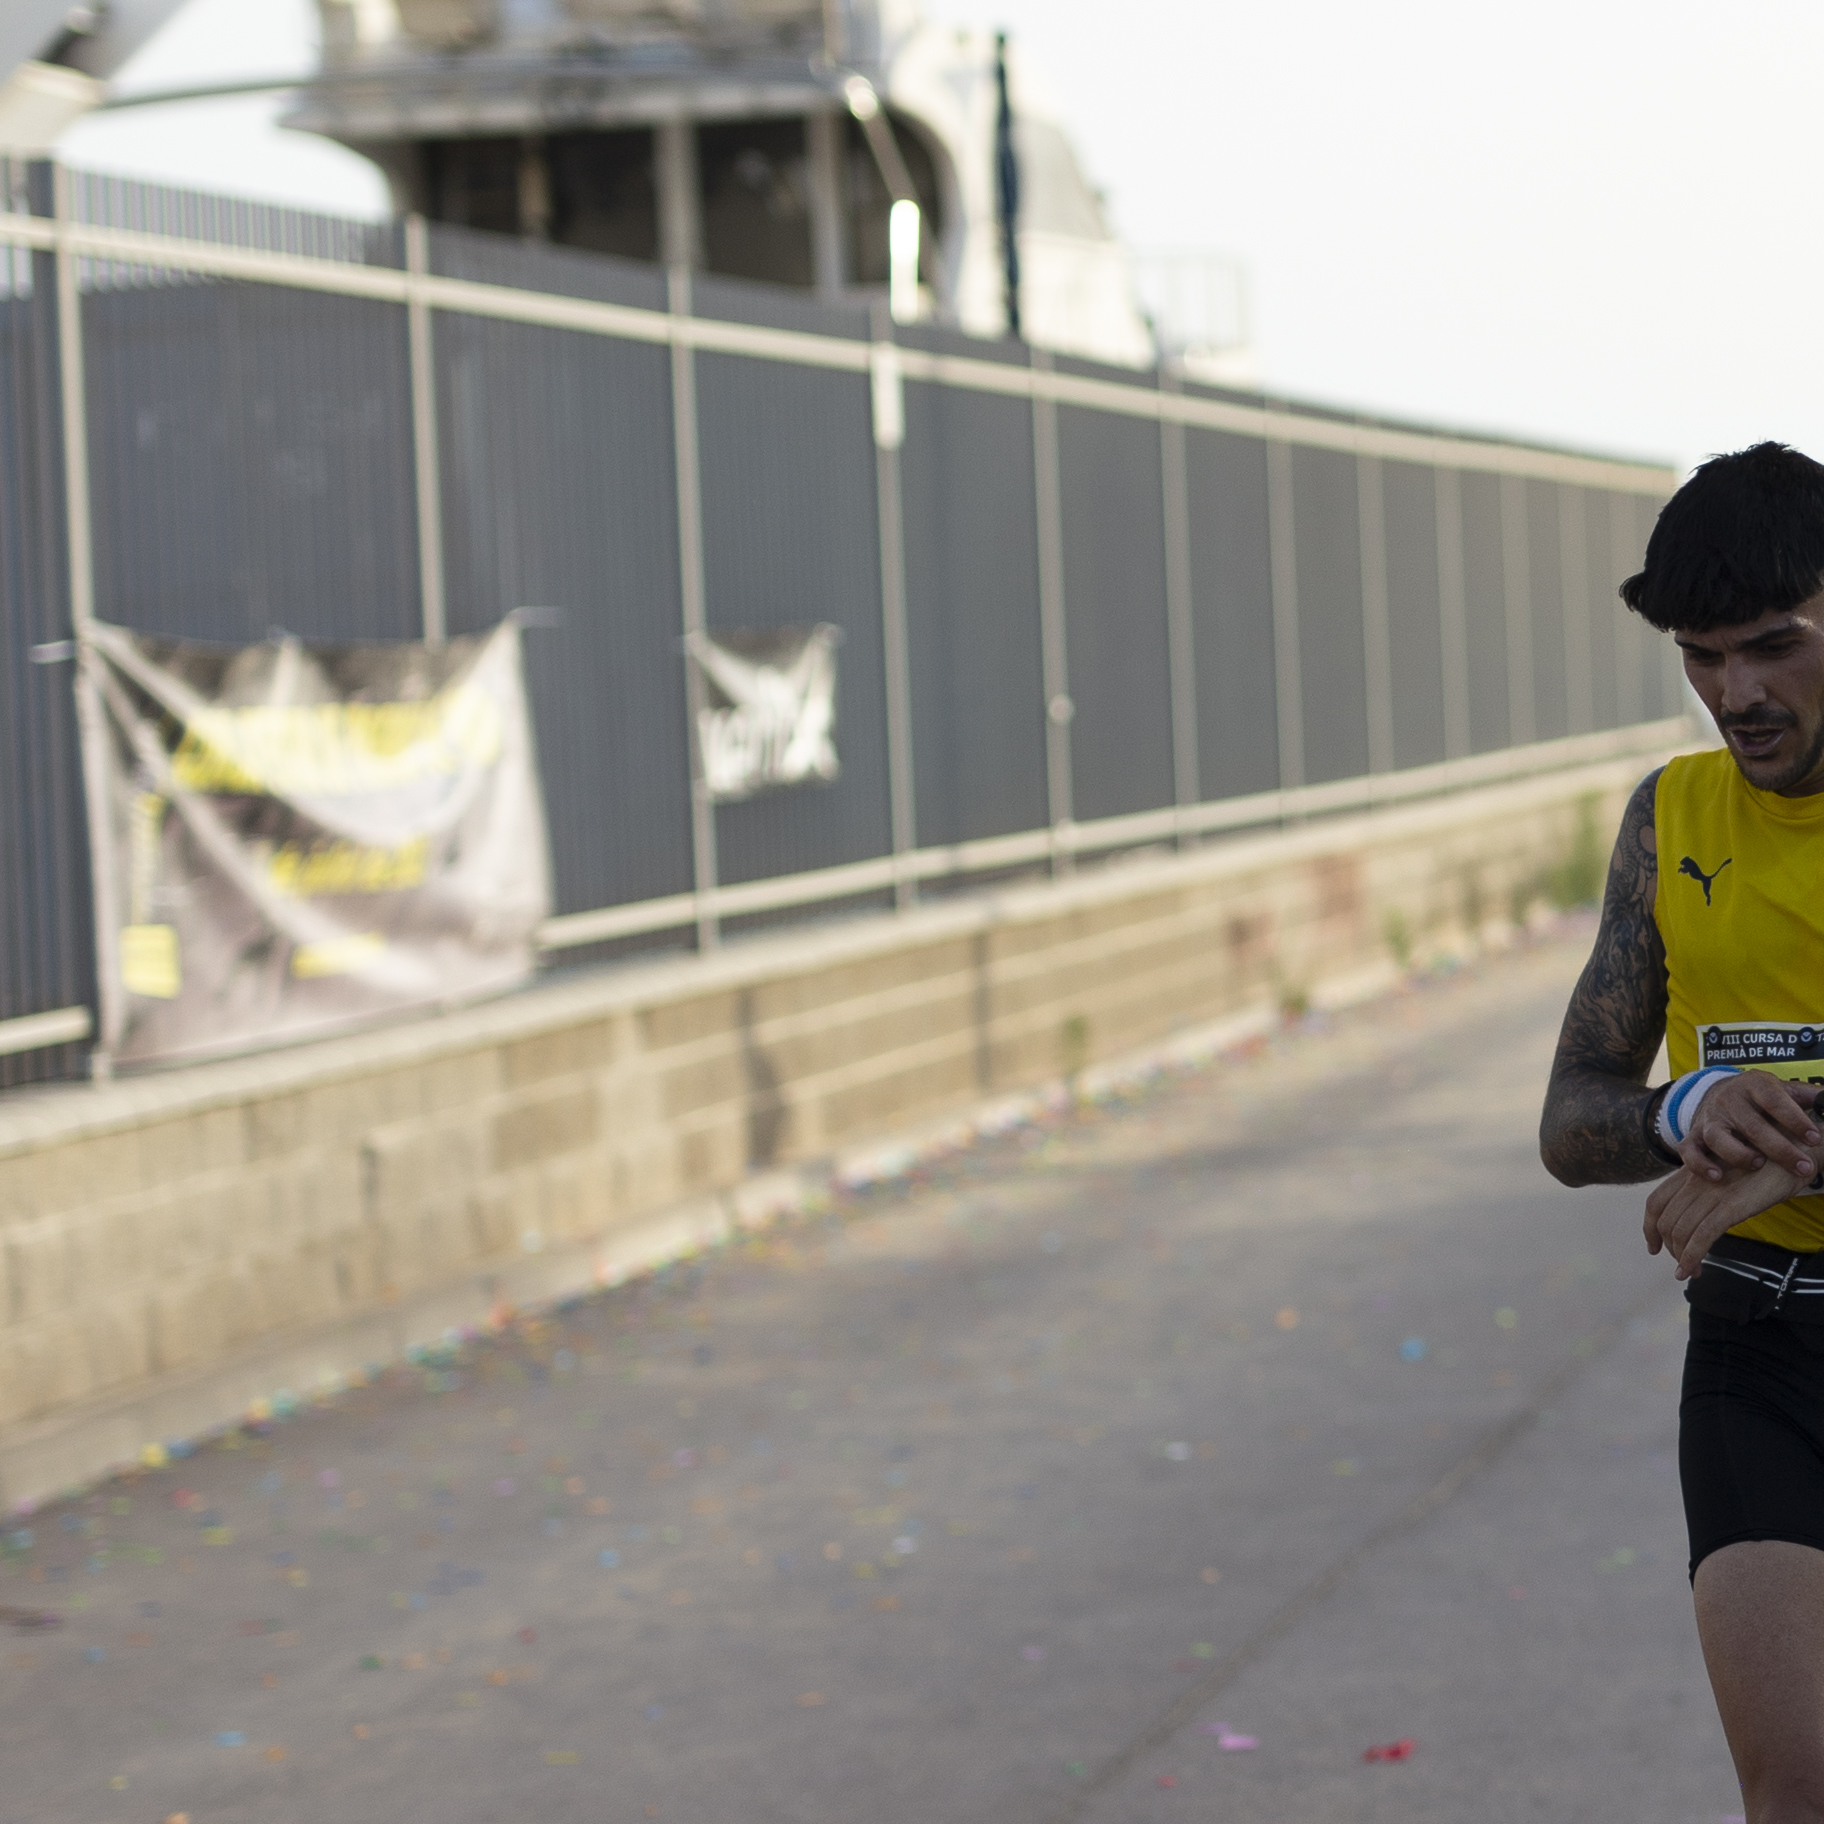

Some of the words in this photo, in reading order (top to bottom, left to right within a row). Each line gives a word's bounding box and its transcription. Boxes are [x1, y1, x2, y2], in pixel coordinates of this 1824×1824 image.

[1742, 1032, 1784, 1044] CURSA
[1707, 1044, 1747, 1060] PREMIÀ
[1749, 1047, 1764, 1058] DE
[1766, 1046, 1796, 1057] MAR
